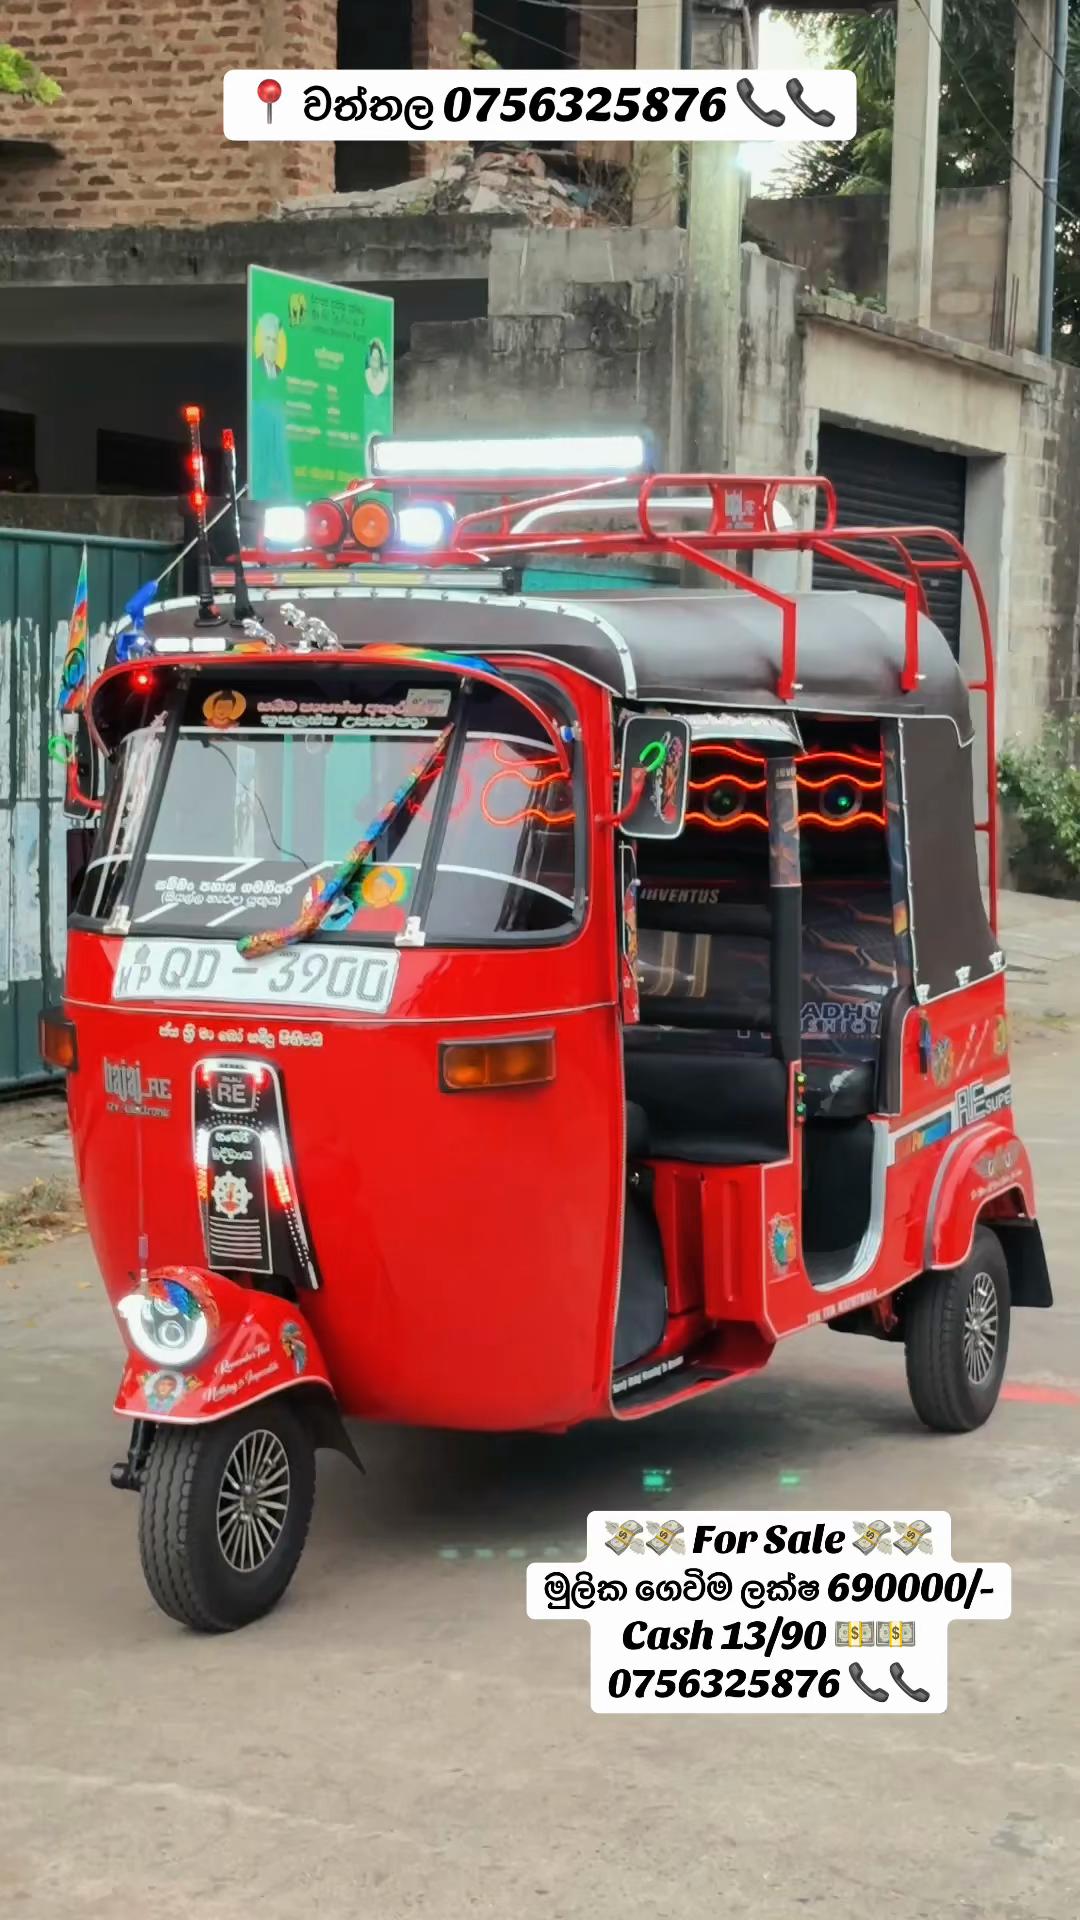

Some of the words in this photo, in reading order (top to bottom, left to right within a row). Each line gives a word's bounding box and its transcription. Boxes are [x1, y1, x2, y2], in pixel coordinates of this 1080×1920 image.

[159, 947, 221, 990] QD
[268, 951, 388, 1001] 3900
[217, 1082, 246, 1104] RE
[955, 1080, 985, 1128] RE
